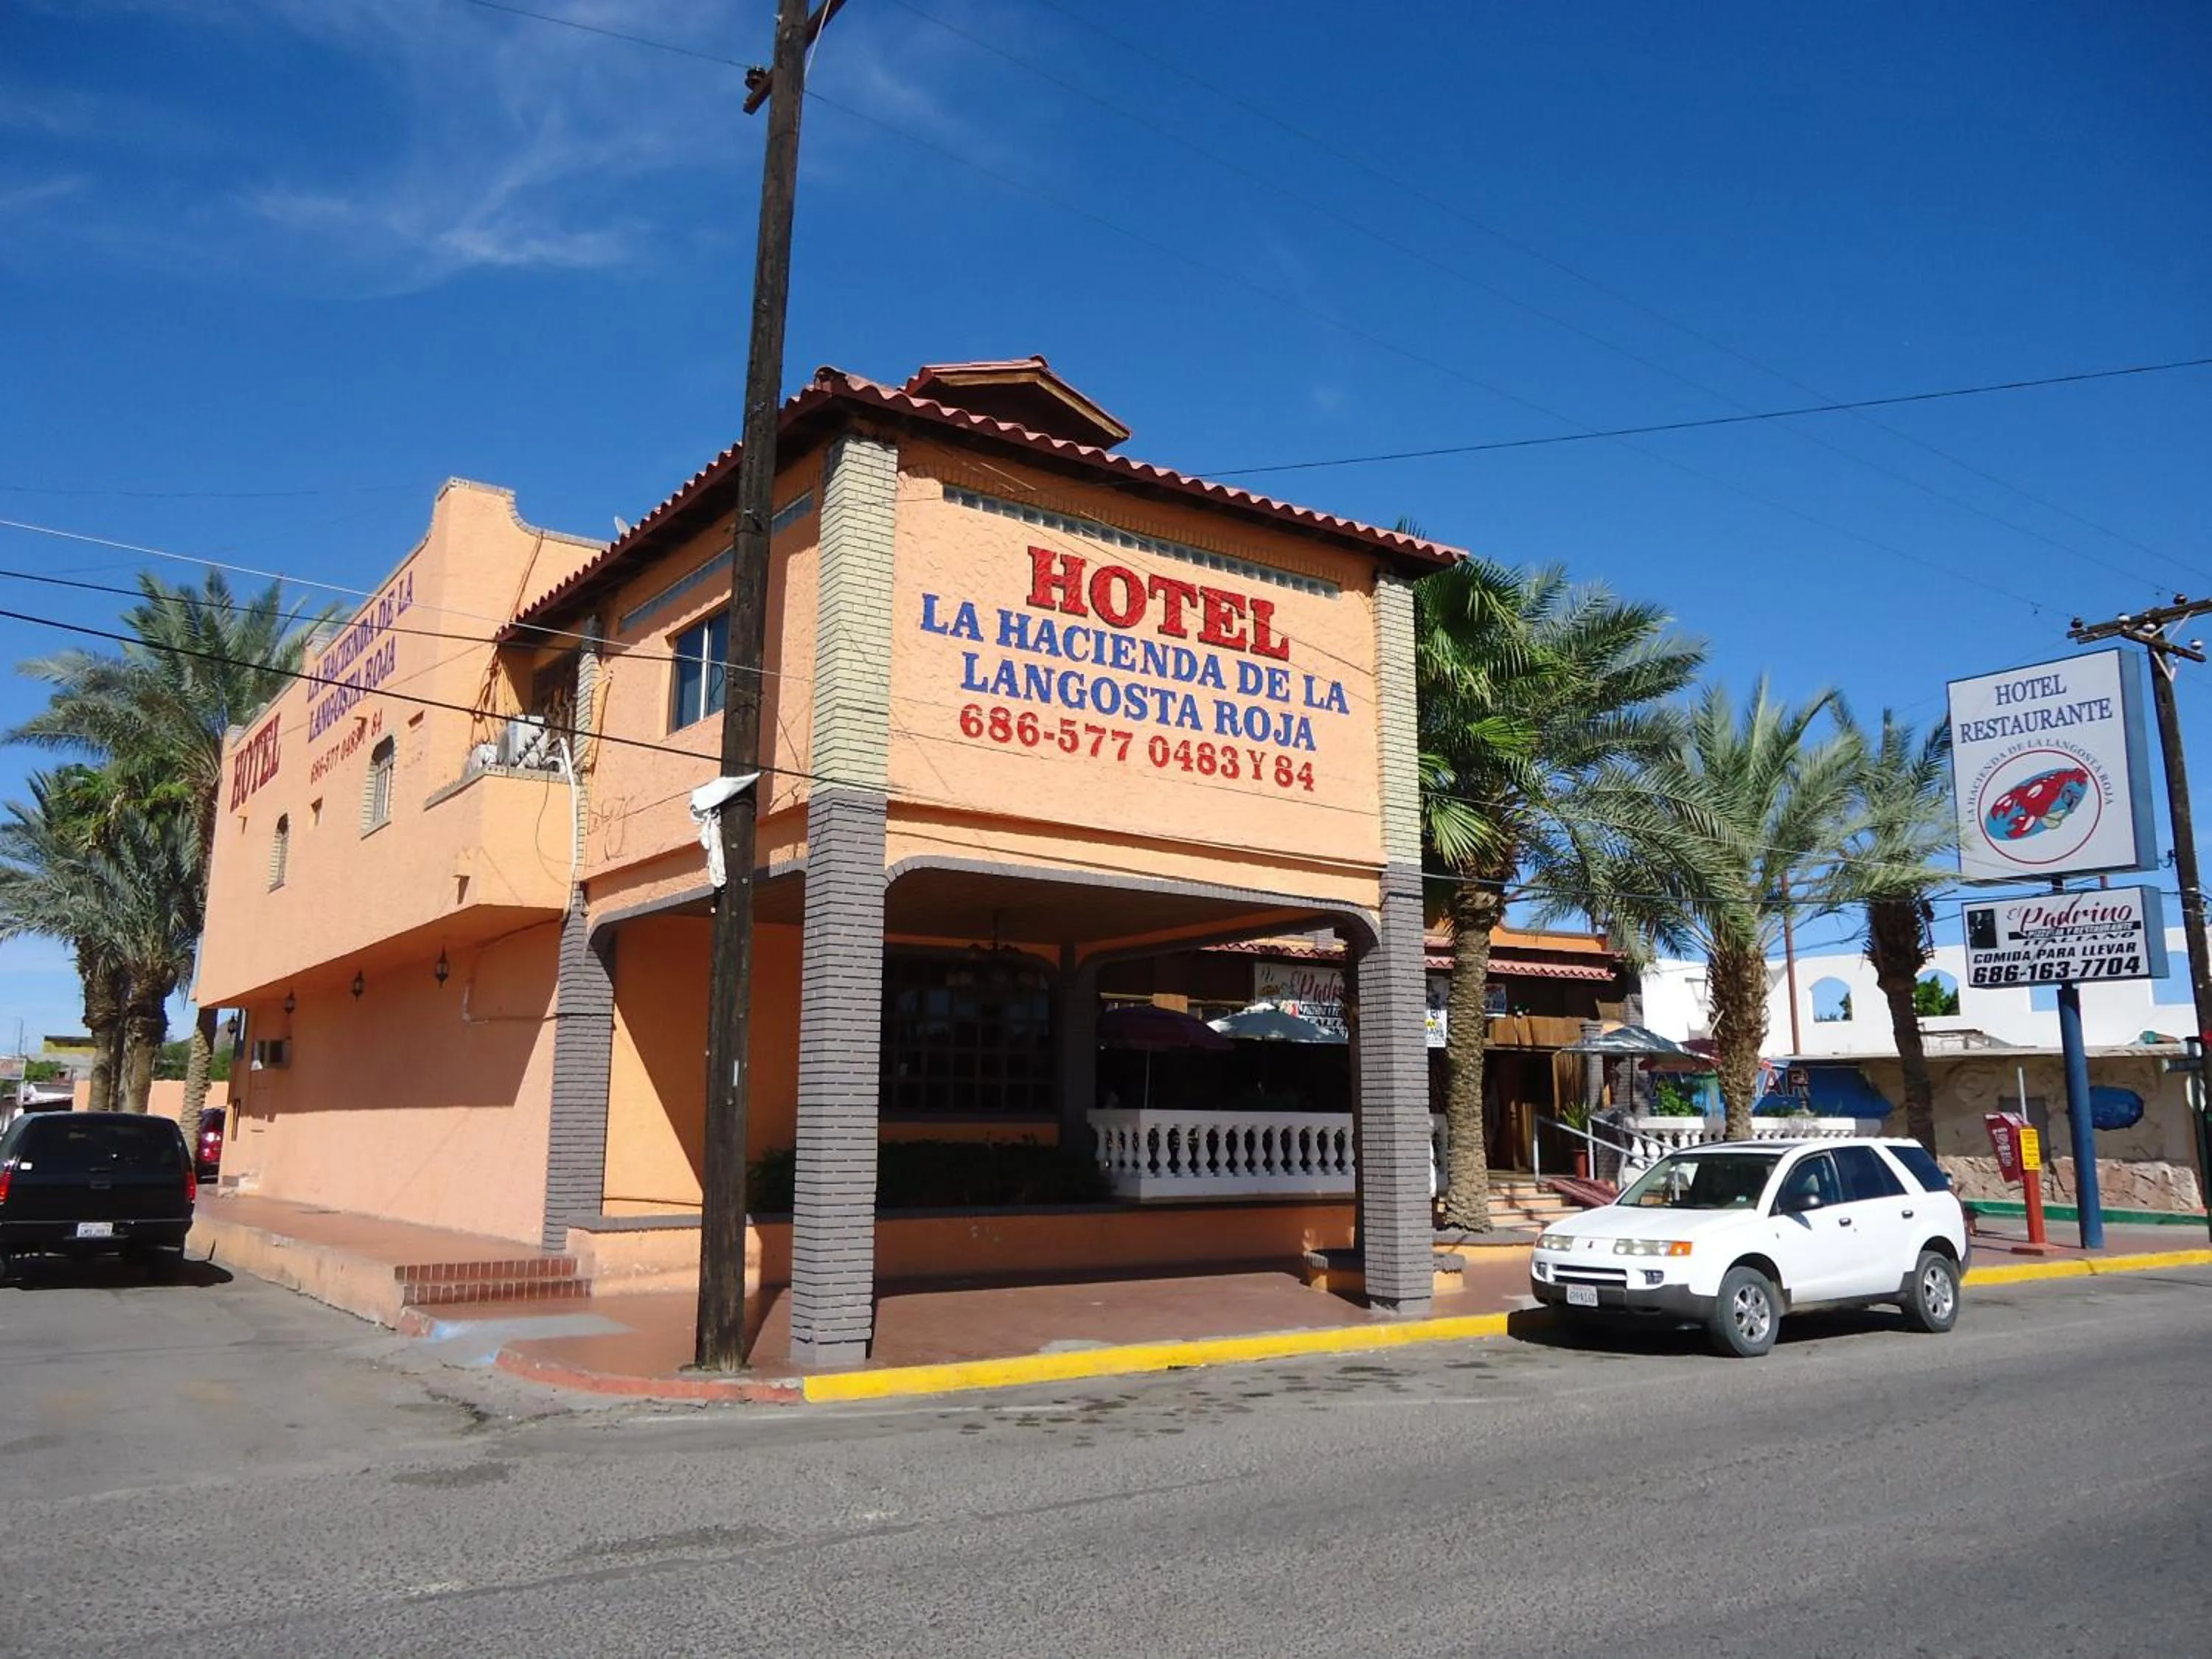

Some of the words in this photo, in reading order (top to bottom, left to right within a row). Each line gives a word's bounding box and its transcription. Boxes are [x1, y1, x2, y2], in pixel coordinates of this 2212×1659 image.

[377, 589, 394, 637] DE
[397, 570, 413, 616] LA
[1026, 545, 1289, 661] HOTEL
[364, 635, 395, 696] ROJA
[920, 594, 984, 642] LA
[995, 608, 1229, 689] HACIENDA
[1237, 661, 1290, 702] DE
[1303, 675, 1350, 714] LA
[961, 652, 1203, 731] LANGOSTA
[1214, 700, 1316, 751] ROJA
[1994, 674, 2067, 706] HOTEL
[1959, 698, 2112, 743] RESTAURANTE
[230, 712, 281, 813] HOTEL
[959, 703, 1134, 762] 686-577
[1148, 734, 1241, 779] 0483
[1273, 757, 1315, 792] 84
[2008, 742, 2024, 754] DE
[2028, 740, 2042, 748] LA
[2045, 738, 2102, 773] LANGOSTA
[2006, 905, 2020, 920] El
[2019, 893, 2132, 933] Padrino
[2023, 931, 2135, 946] ITALIANO
[1972, 956, 2140, 984] 686-163-7704
[1973, 950, 2031, 964] COMIDA
[2037, 947, 2076, 959] PARA
[2082, 942, 2137, 957] LLEVAR
